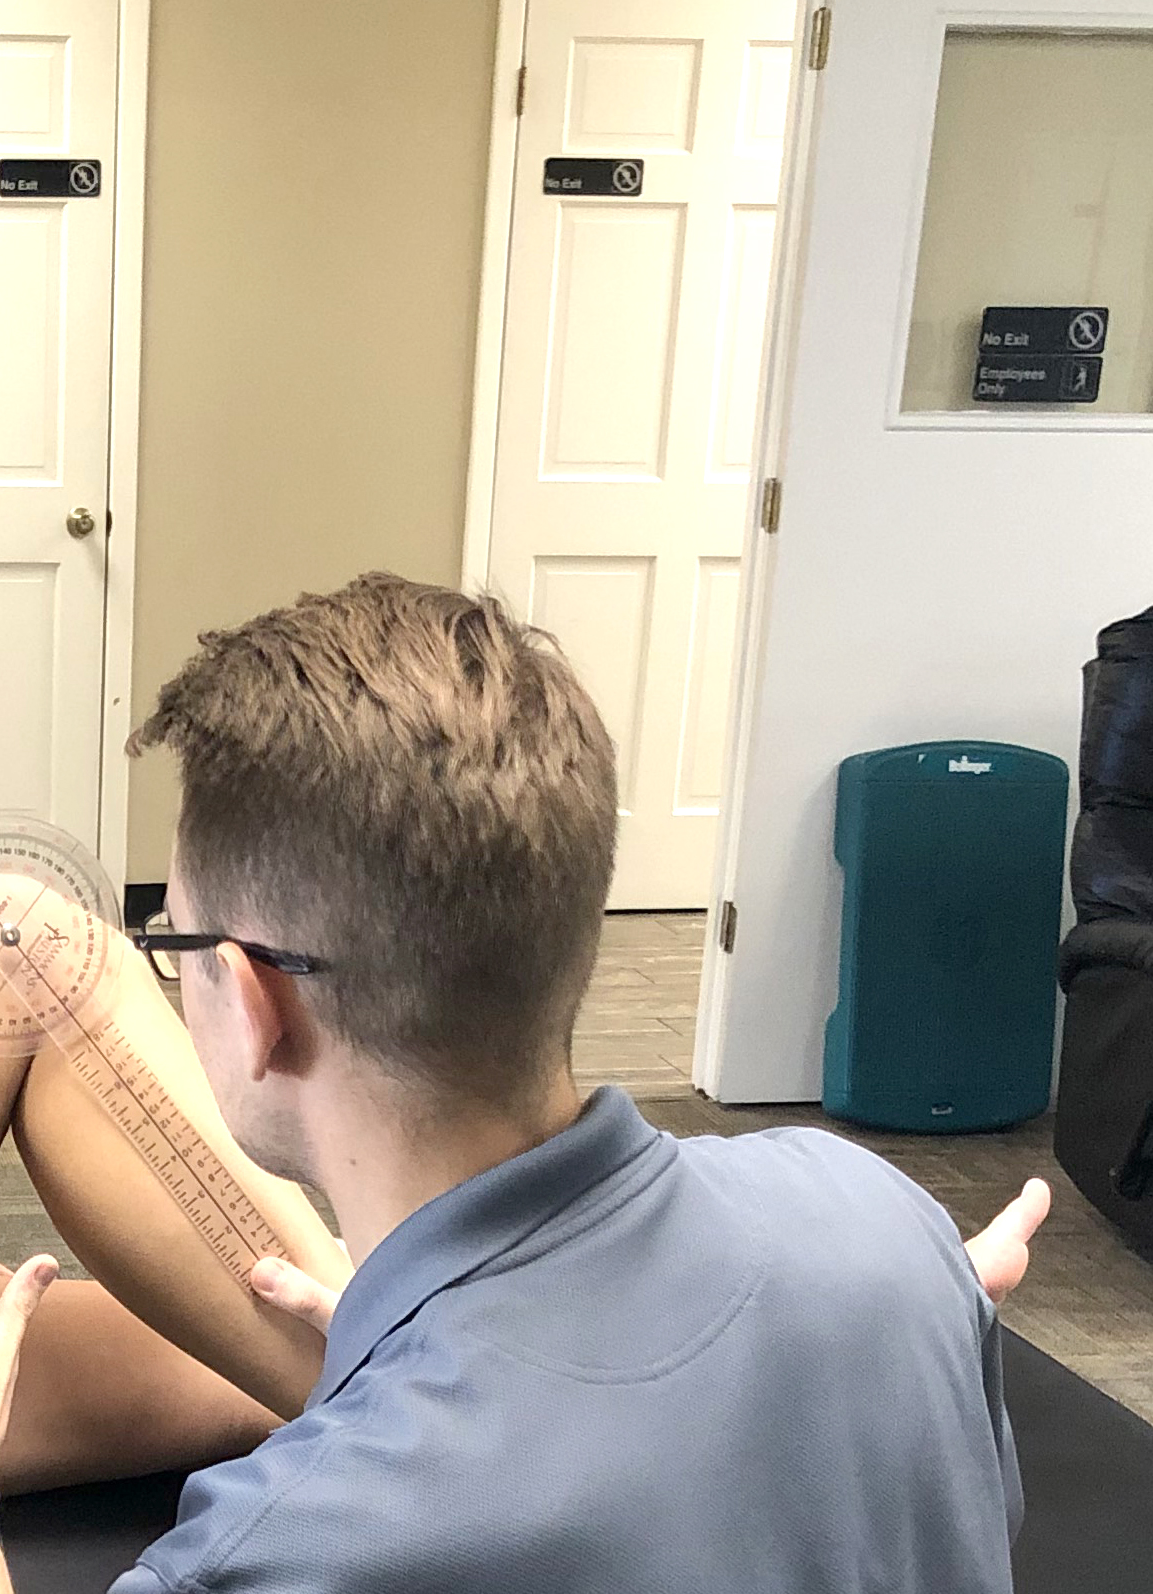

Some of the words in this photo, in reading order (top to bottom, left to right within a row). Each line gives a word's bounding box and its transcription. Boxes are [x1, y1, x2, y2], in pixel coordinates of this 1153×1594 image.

[0, 179, 15, 190] No
[18, 180, 38, 190] Exit
[562, 178, 582, 189] Exit
[982, 332, 1001, 345] No
[1004, 333, 1029, 346] Exit
[980, 367, 1045, 382] Employees
[977, 382, 1005, 397] Only
[93, 1031, 104, 1042] 18
[126, 1075, 138, 1086] 15
[159, 1118, 171, 1129] 12
[182, 1146, 193, 1158] 10
